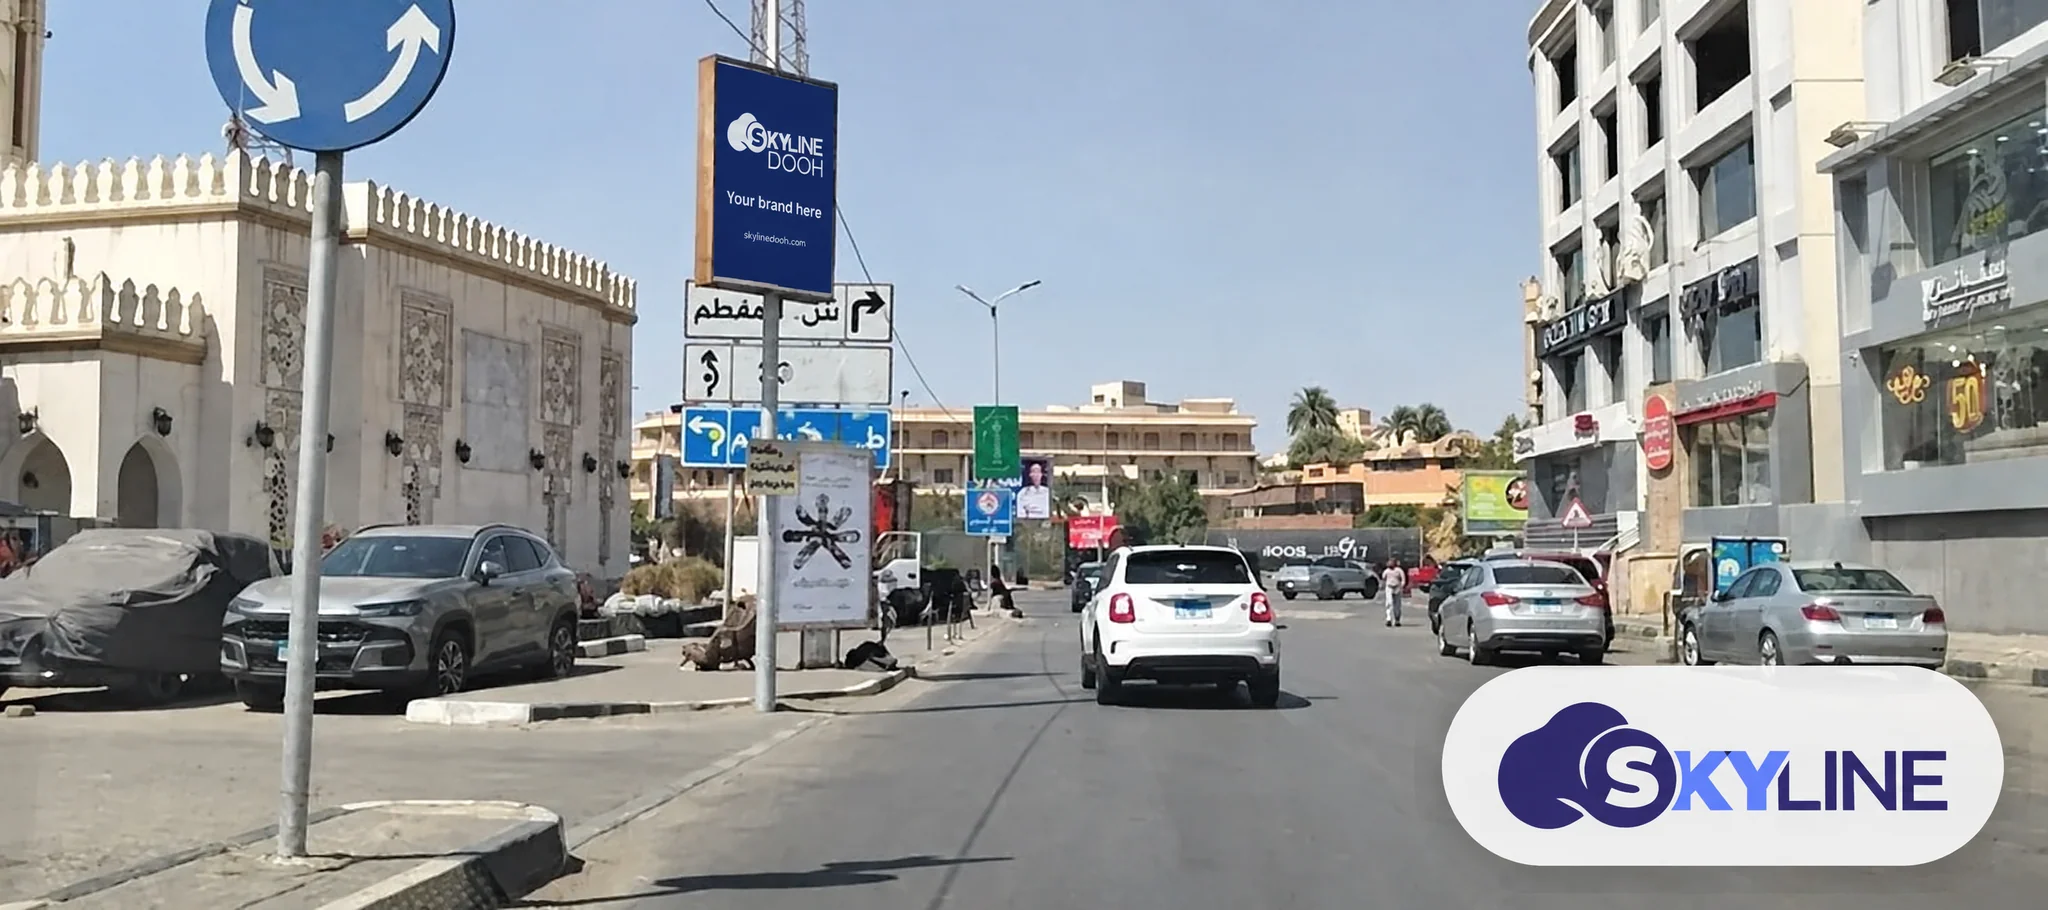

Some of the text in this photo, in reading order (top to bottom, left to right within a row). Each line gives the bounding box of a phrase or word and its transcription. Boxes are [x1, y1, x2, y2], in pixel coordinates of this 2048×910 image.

[751, 126, 824, 157] SKYLINE
[767, 151, 824, 178] DOOH
[726, 190, 822, 219] Your brand here
[743, 230, 807, 248] skylinedooh.com
[694, 297, 784, 325] امقطم
